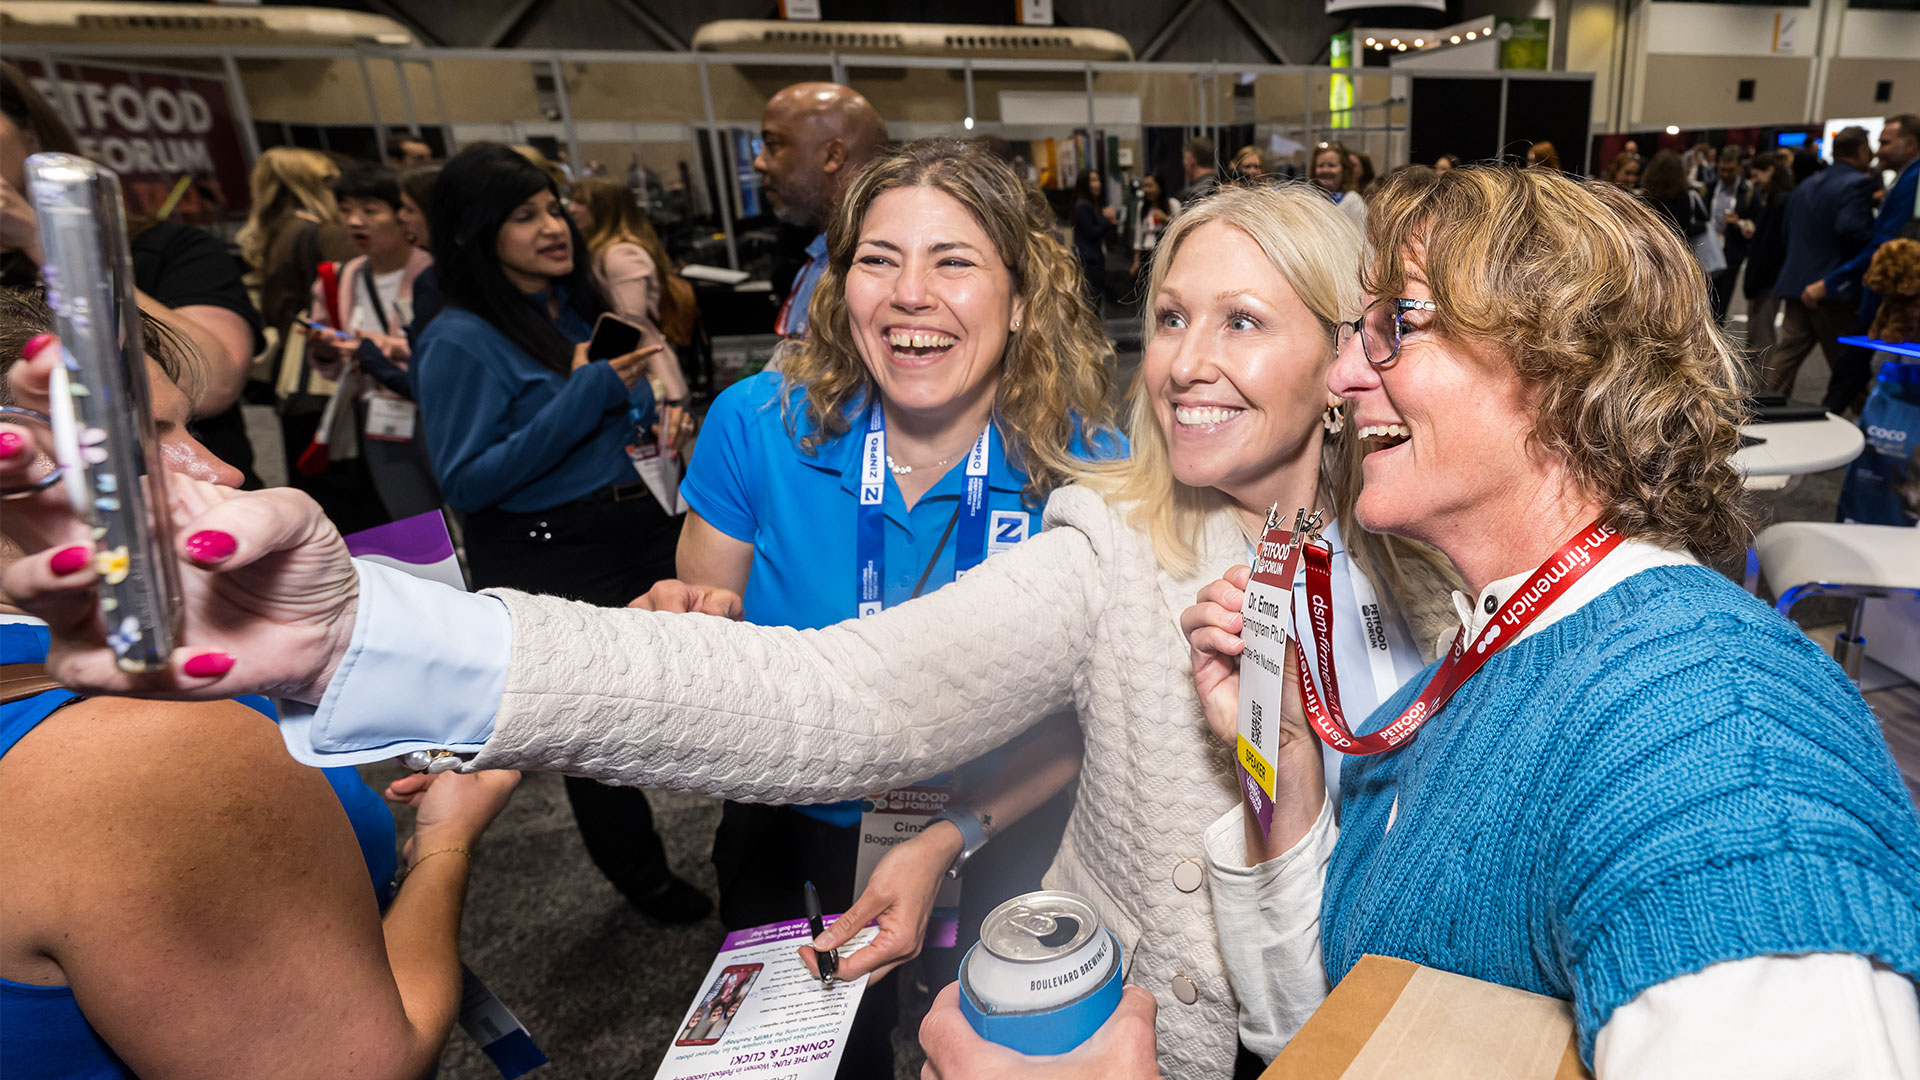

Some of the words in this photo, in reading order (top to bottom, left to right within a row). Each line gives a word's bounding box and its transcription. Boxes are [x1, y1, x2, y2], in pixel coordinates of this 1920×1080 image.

[29, 76, 212, 133] ETFOOD
[869, 437, 879, 479] ZINPRO
[1262, 541, 1290, 560] PETFOOD
[1263, 560, 1284, 576] FORUM
[1501, 524, 1617, 625] sm-firmenich
[1248, 591, 1257, 611] Dr.
[1258, 595, 1279, 619] Emma
[1240, 611, 1270, 640] ermingham
[1364, 616, 1378, 649] FORUM
[1369, 603, 1388, 652] PETFOOD
[1260, 653, 1280, 677] Nutrition
[1379, 701, 1426, 741] PETFOOD
[1245, 748, 1266, 782] SPEAKER
[889, 790, 950, 803] PETFOOD
[905, 801, 944, 810] FORUM
[893, 821, 924, 833] Cinz
[735, 937, 764, 946] connection
[1030, 969, 1080, 991] BOULEVARD
[1079, 947, 1105, 976] BREWING
[771, 1049, 778, 1059] &
[781, 1039, 835, 1057] CONNECT
[810, 1051, 832, 1061] JOIN
[730, 1052, 765, 1065] CLICK!
[744, 1063, 769, 1071] Women
[772, 1059, 792, 1068] FUN:
[795, 1056, 808, 1064] THE
[708, 1069, 734, 1078] Petfood
